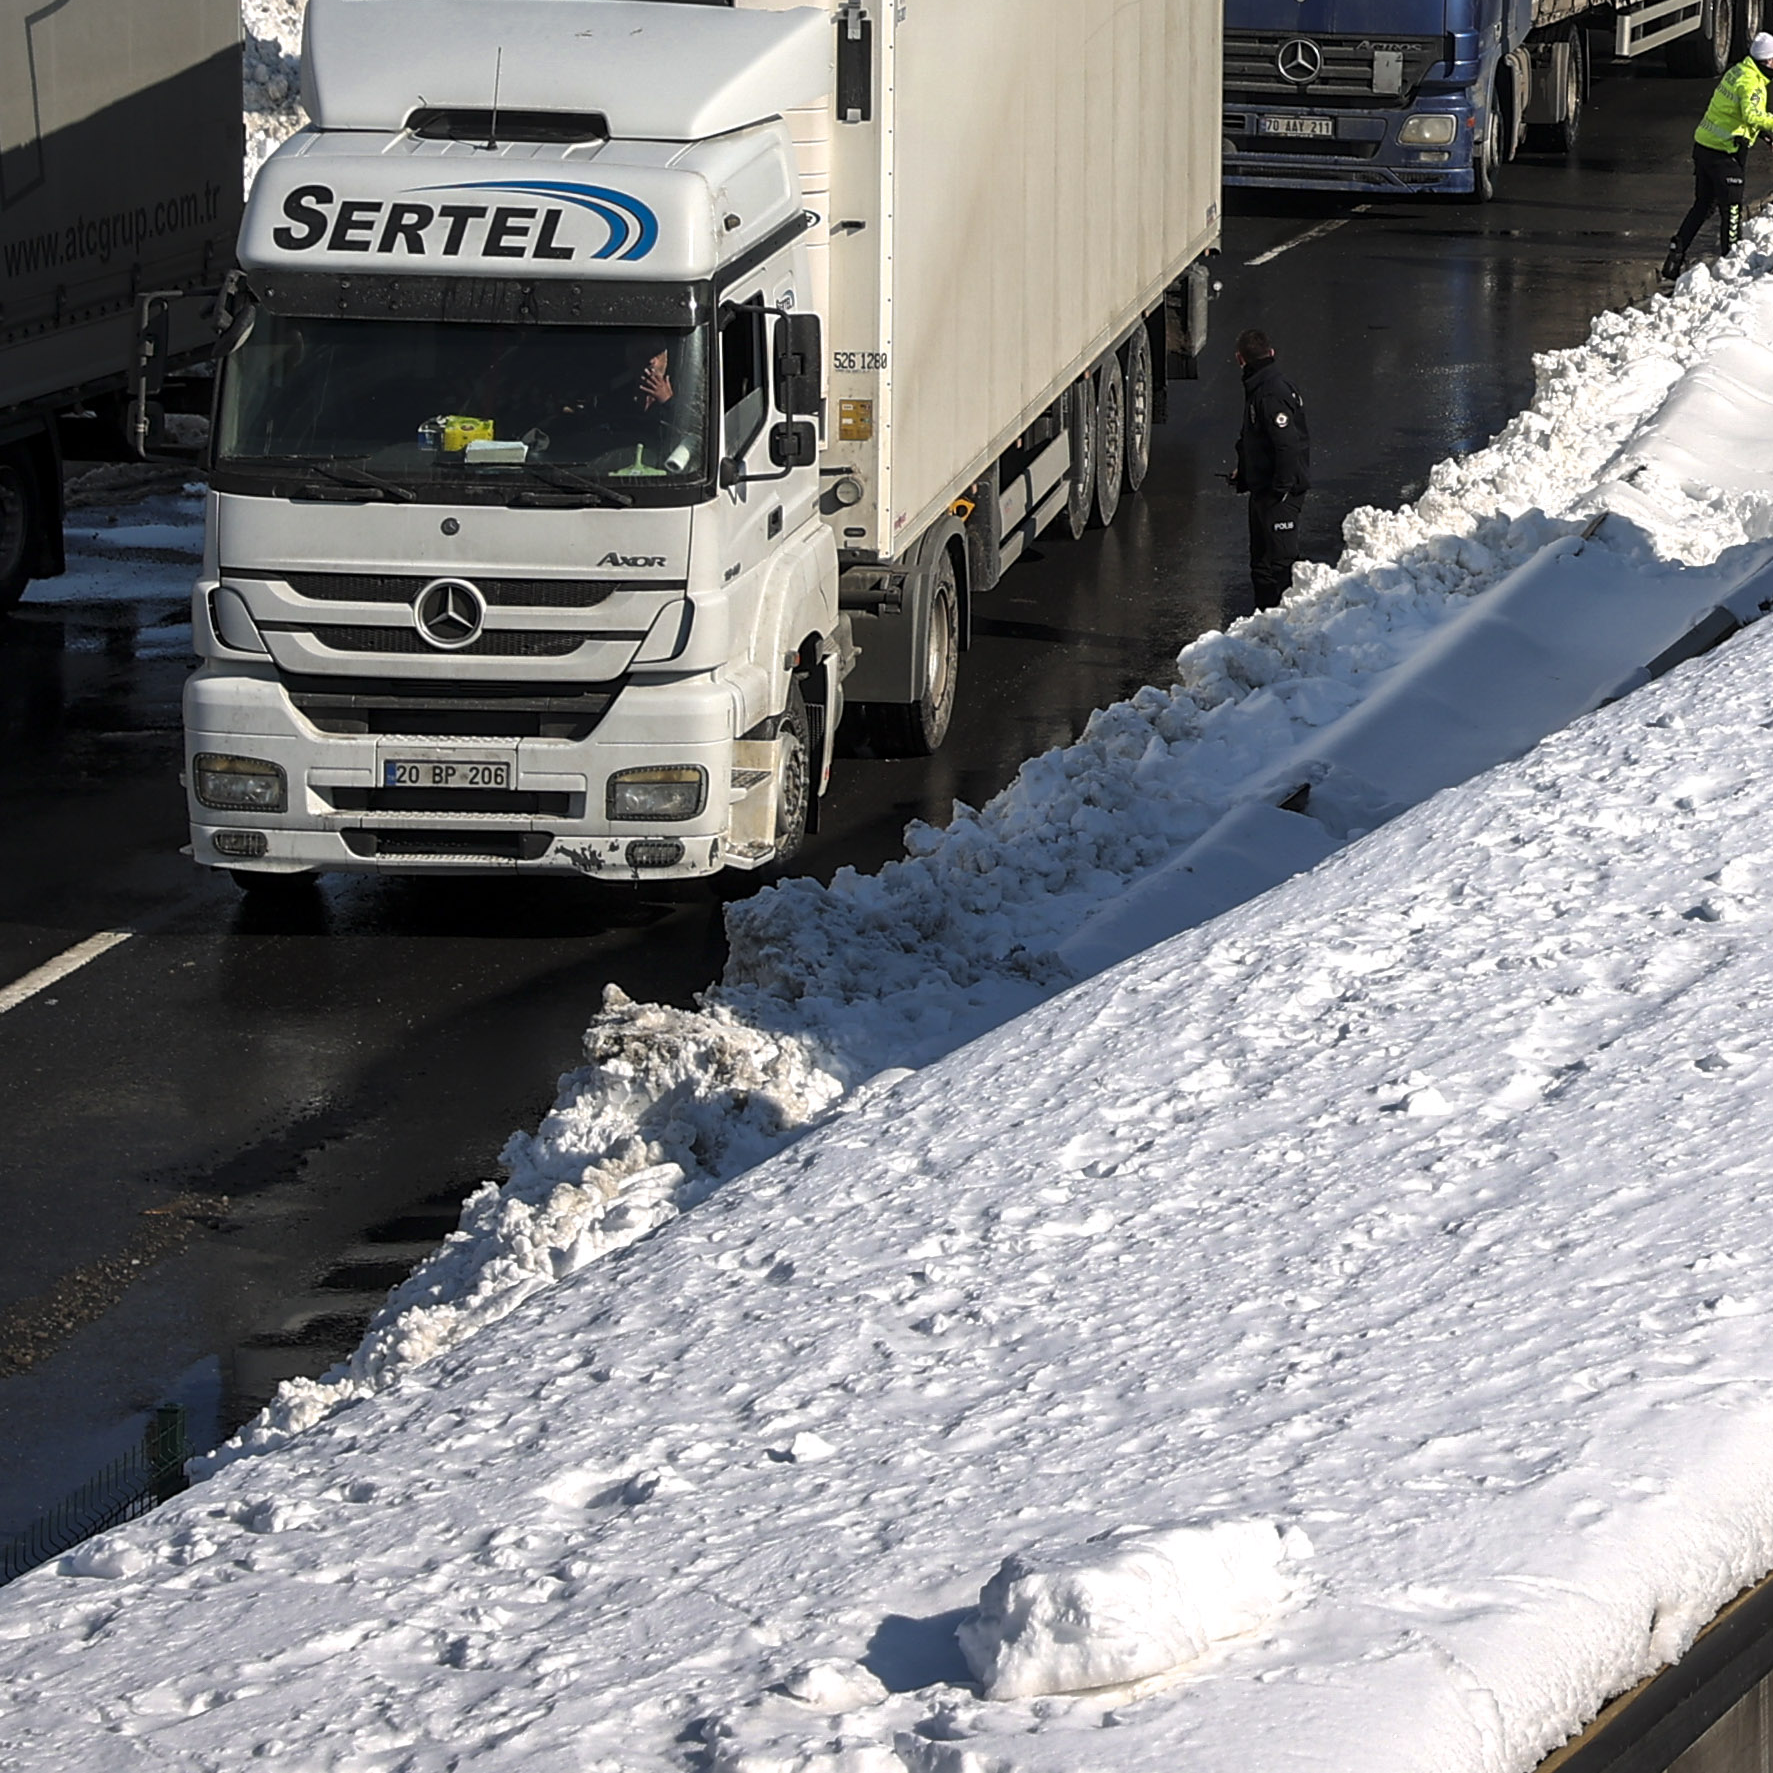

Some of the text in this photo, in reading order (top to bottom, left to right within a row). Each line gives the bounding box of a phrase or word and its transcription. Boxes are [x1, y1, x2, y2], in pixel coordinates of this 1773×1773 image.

[1266, 119, 1280, 132] 70
[1310, 120, 1332, 134] 211
[833, 352, 856, 370] 526
[395, 765, 505, 786] 20 BP 206
